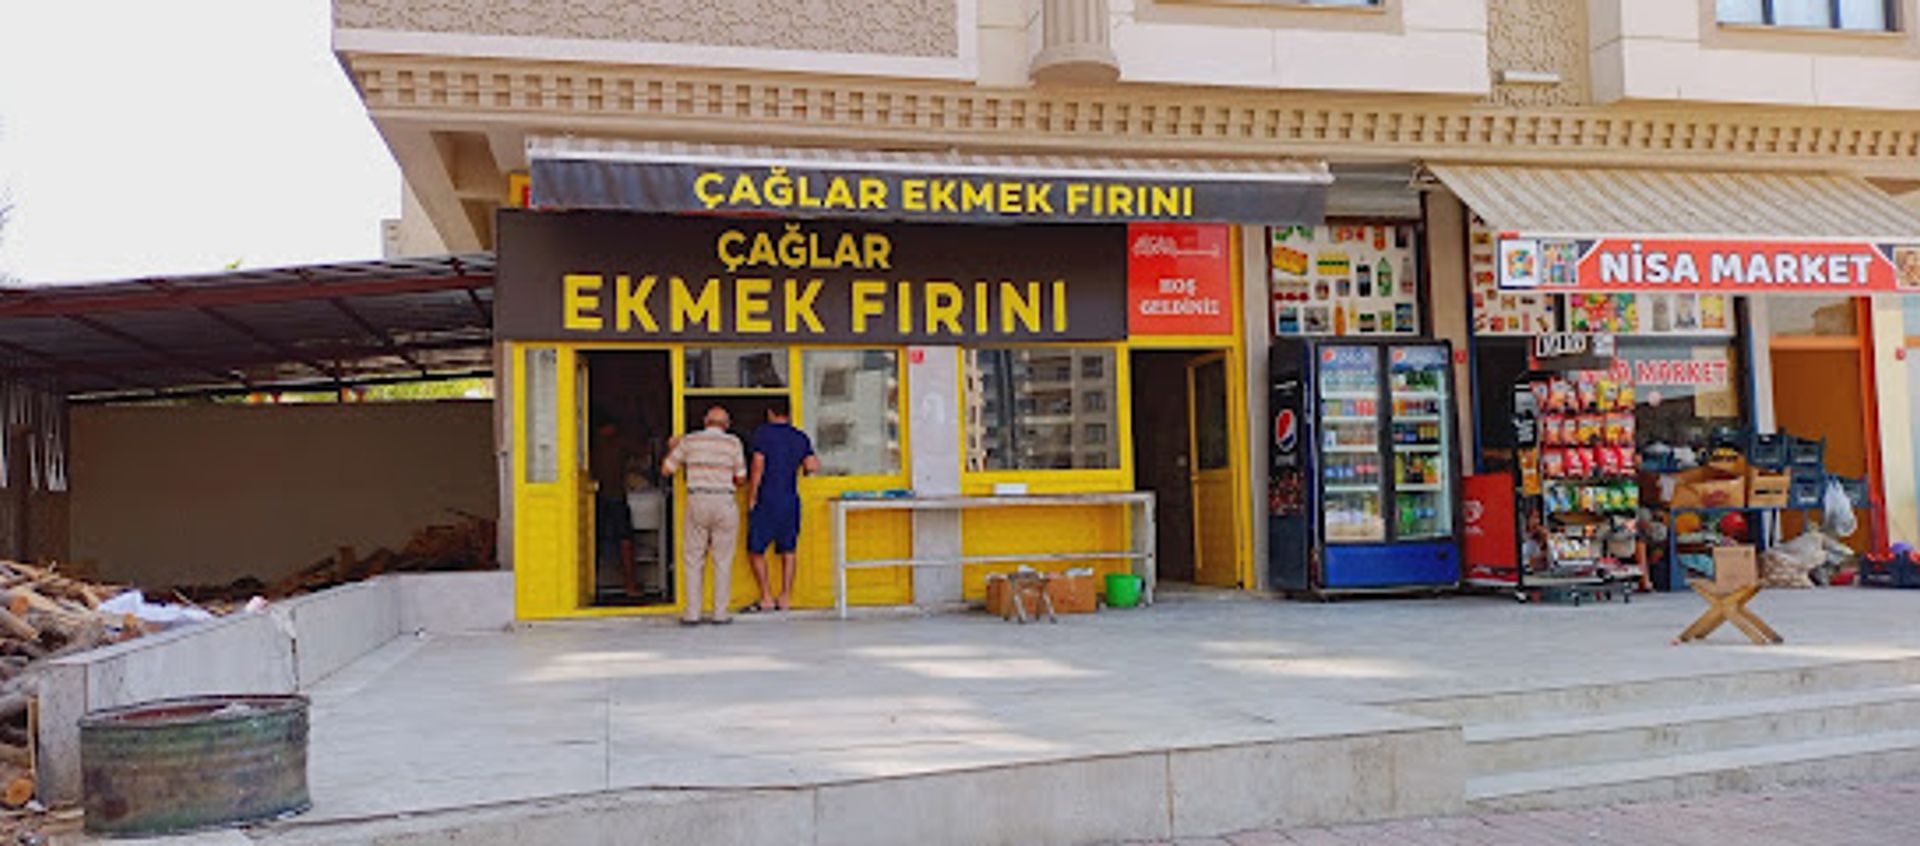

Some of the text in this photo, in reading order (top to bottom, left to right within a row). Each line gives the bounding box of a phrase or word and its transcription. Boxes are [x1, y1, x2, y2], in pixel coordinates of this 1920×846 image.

[695, 167, 1194, 216] ÇAĞLAR EKMEK FIRINI
[717, 224, 891, 271] ÇAĞLAR
[1600, 243, 1873, 284] NİSA MARKET
[563, 273, 1068, 334] EKMEK FIRINI
